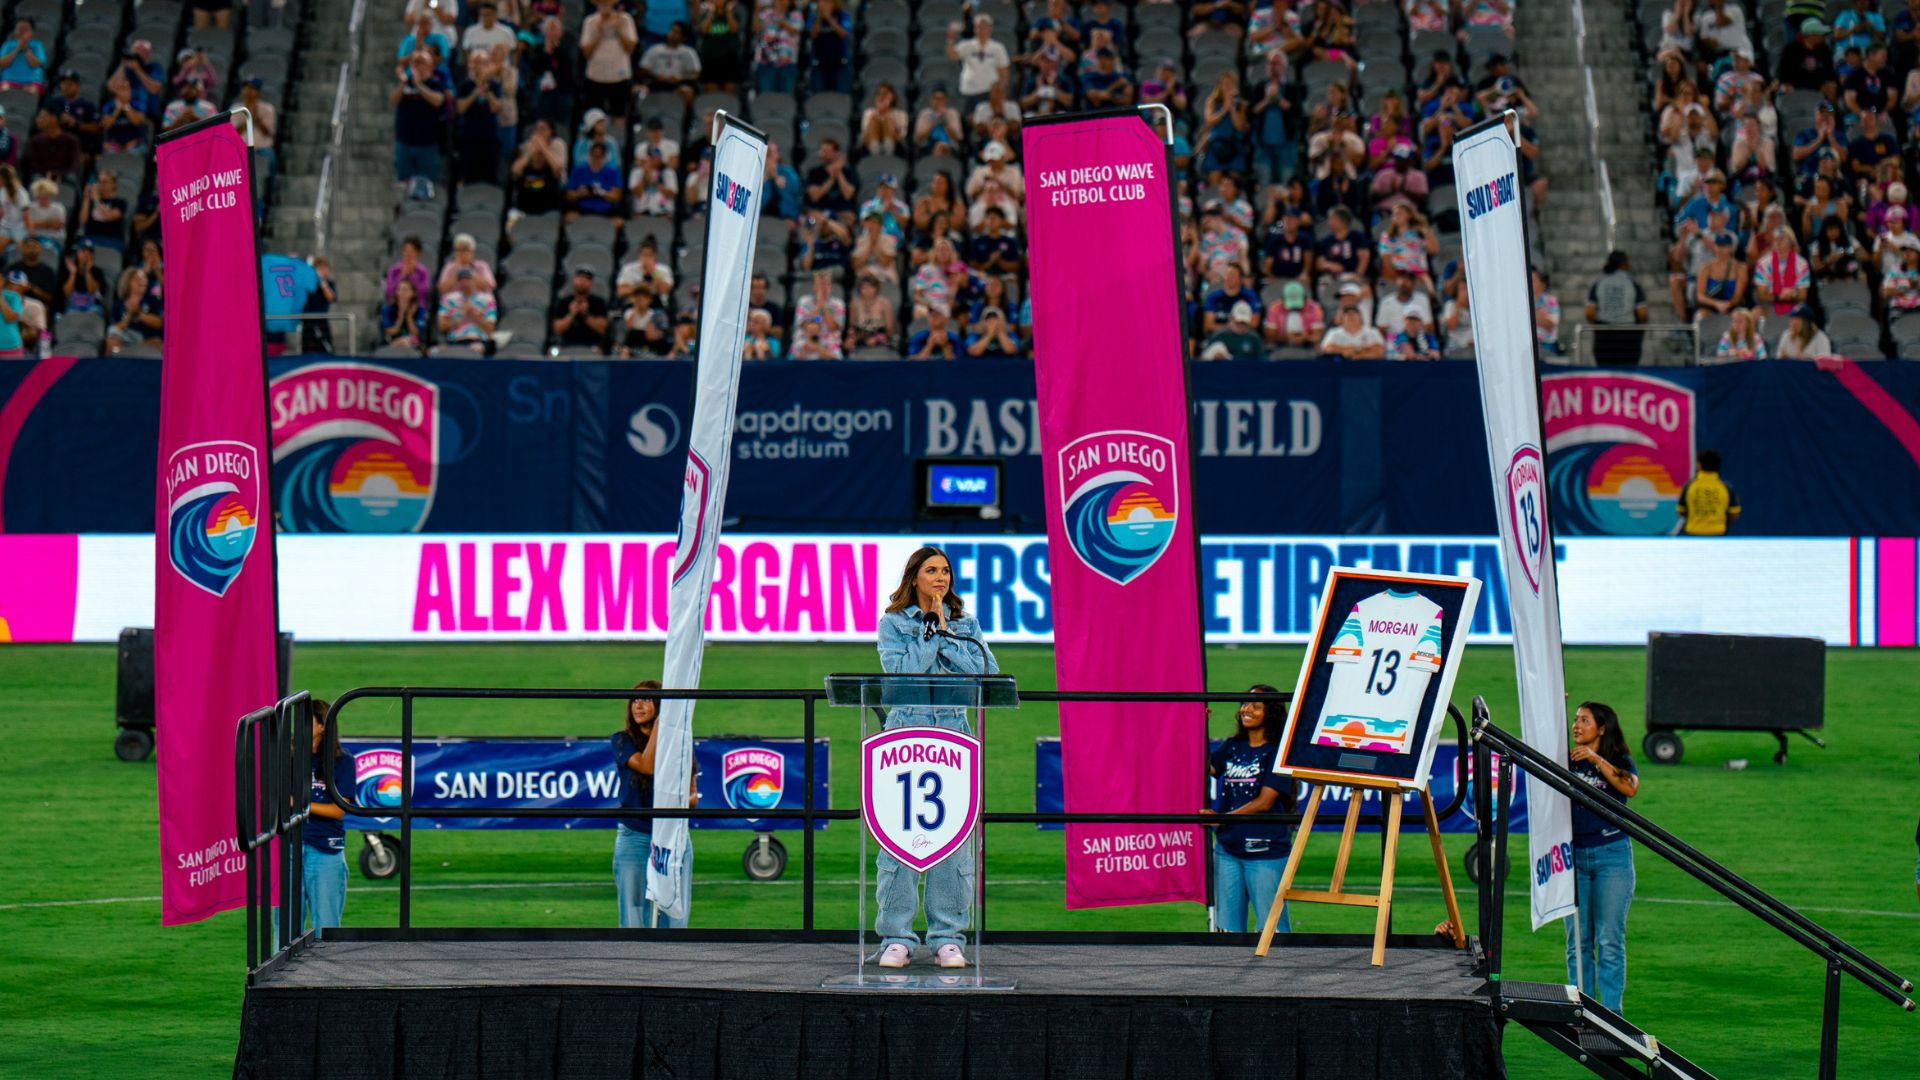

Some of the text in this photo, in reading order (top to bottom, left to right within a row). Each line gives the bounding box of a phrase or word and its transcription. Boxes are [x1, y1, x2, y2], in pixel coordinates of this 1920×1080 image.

[172, 168, 242, 206] SAN DIEO WAVE
[1040, 163, 1155, 188] SAN DIEGO WAVE
[207, 191, 236, 210] CLUB
[1051, 184, 1146, 207] FÚTBOL CLUB
[272, 378, 424, 430] SAN DIEGO
[1543, 386, 1680, 432] AN DIEGO
[731, 404, 892, 440] apdragon
[1193, 400, 1323, 457] IELD
[737, 439, 850, 459] stadium
[1068, 441, 1166, 481] SAN DIEGO
[205, 452, 250, 480] DIEGO
[1519, 490, 1540, 558] 13
[412, 542, 568, 632] ALEX
[583, 541, 878, 633] MORGAN
[1368, 619, 1419, 637] MORGAN
[1364, 648, 1401, 696] 13
[357, 753, 403, 772] SAN DIEG
[728, 752, 780, 770] SAN DIEGO
[880, 743, 962, 771] MORGAN
[434, 771, 488, 799] SAN
[496, 770, 579, 799] DIEGO
[896, 769, 947, 832] 13
[1082, 830, 1194, 855] SAN DIEGO WAVE
[177, 850, 203, 869] SAN
[224, 855, 247, 874] CLU
[1095, 850, 1187, 874] FÚTBOL CLUB
